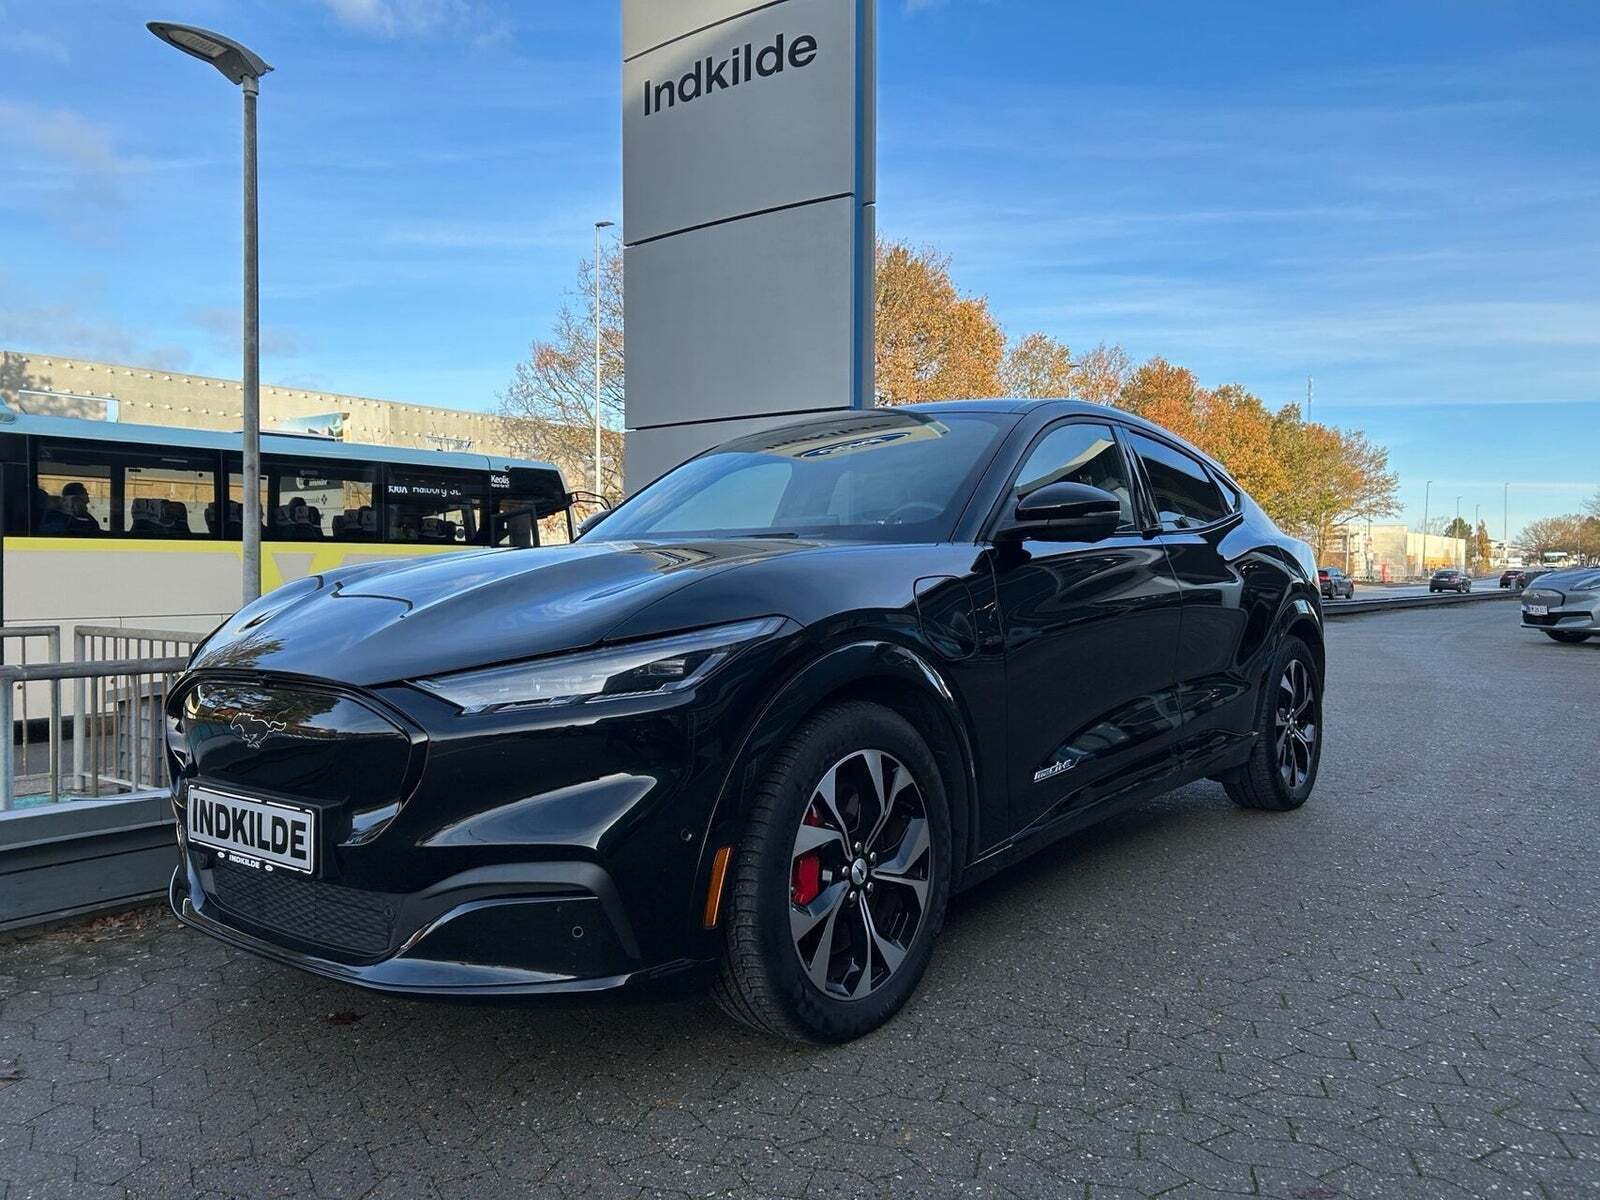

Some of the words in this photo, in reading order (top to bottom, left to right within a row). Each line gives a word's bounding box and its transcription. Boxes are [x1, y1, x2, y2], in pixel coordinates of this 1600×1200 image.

[644, 33, 818, 117] Indkilde
[490, 474, 510, 485] Keolis
[192, 797, 307, 861] INDKILDE
[228, 854, 261, 869] INDKILDE
